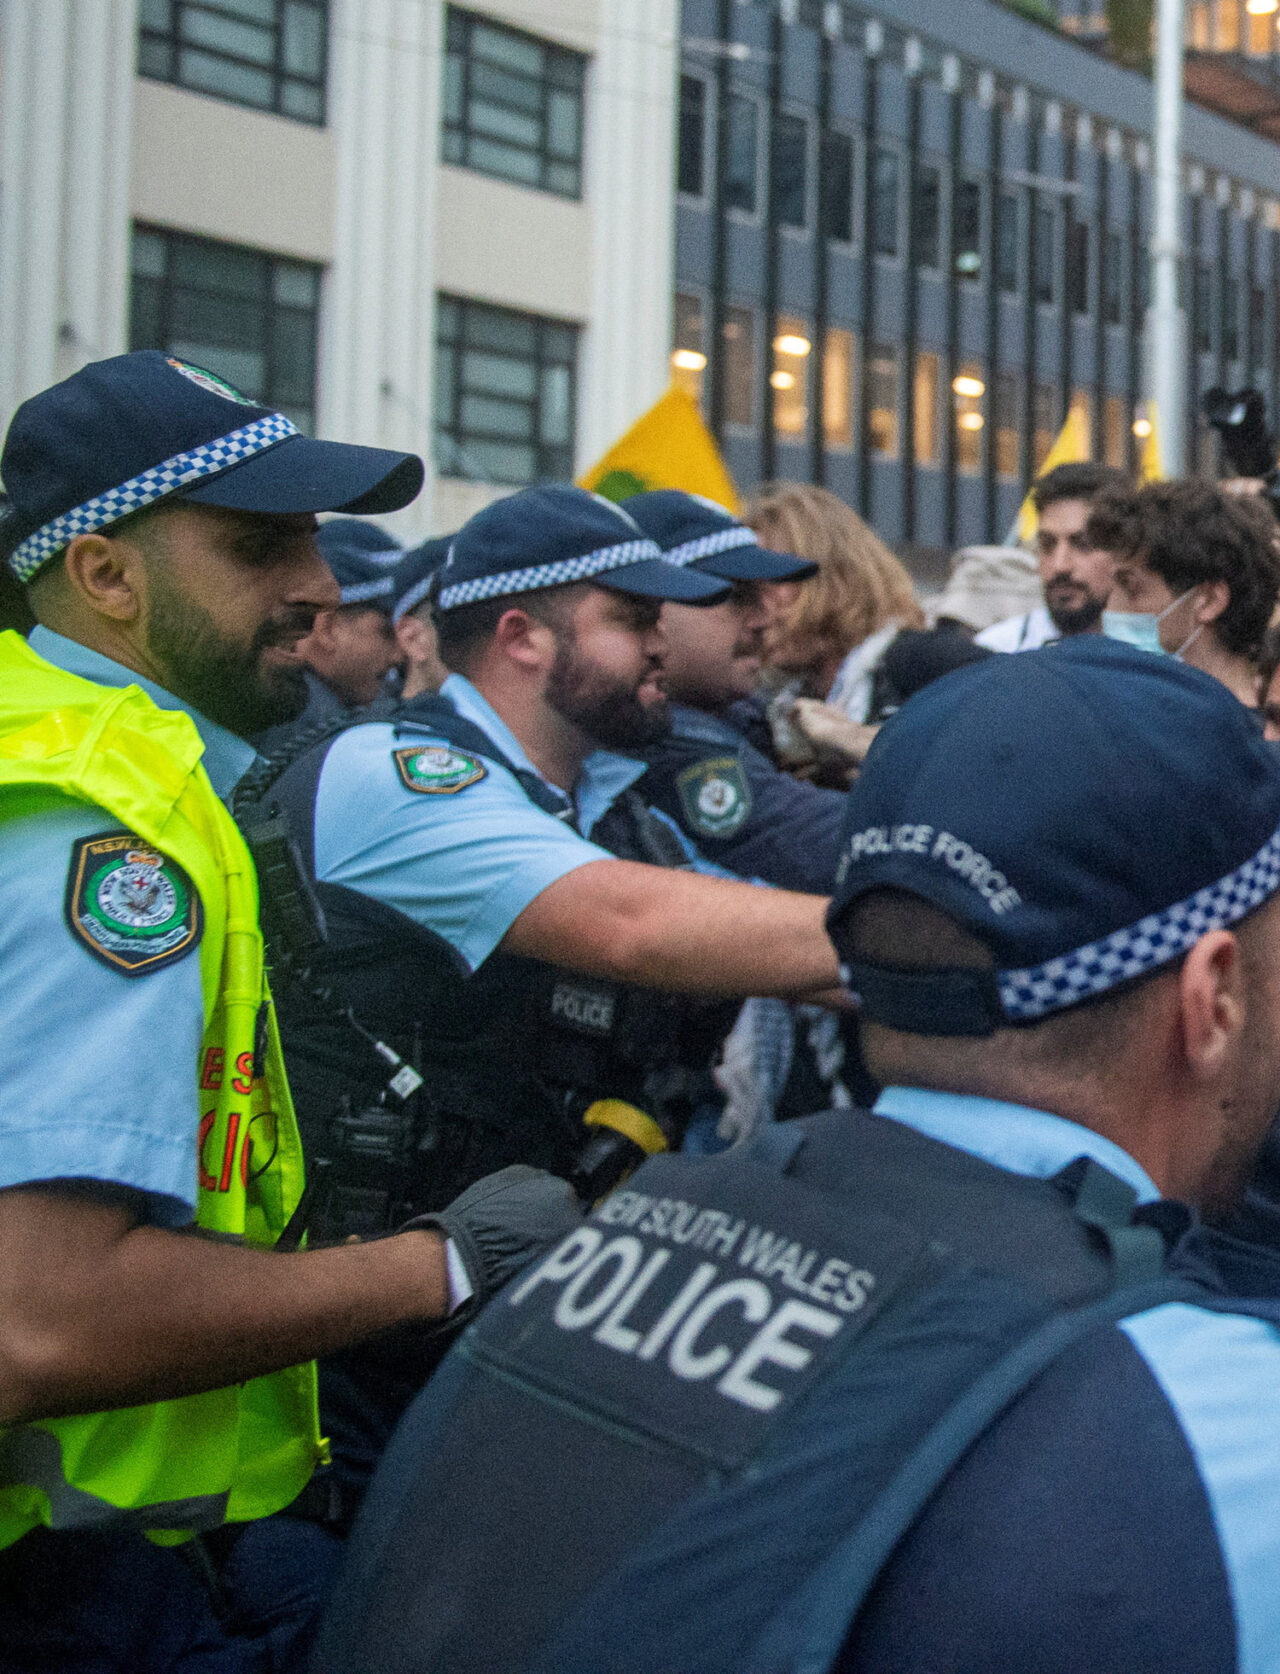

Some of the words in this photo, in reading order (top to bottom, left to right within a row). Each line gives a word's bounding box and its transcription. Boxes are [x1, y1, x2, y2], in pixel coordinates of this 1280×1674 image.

[851, 824, 934, 860] POLICE
[931, 831, 1022, 915] FORCE
[551, 992, 613, 1030] POLICE
[638, 1197, 746, 1257] SOUTH
[738, 1226, 875, 1312] WALES
[508, 1226, 843, 1412] POLICE
